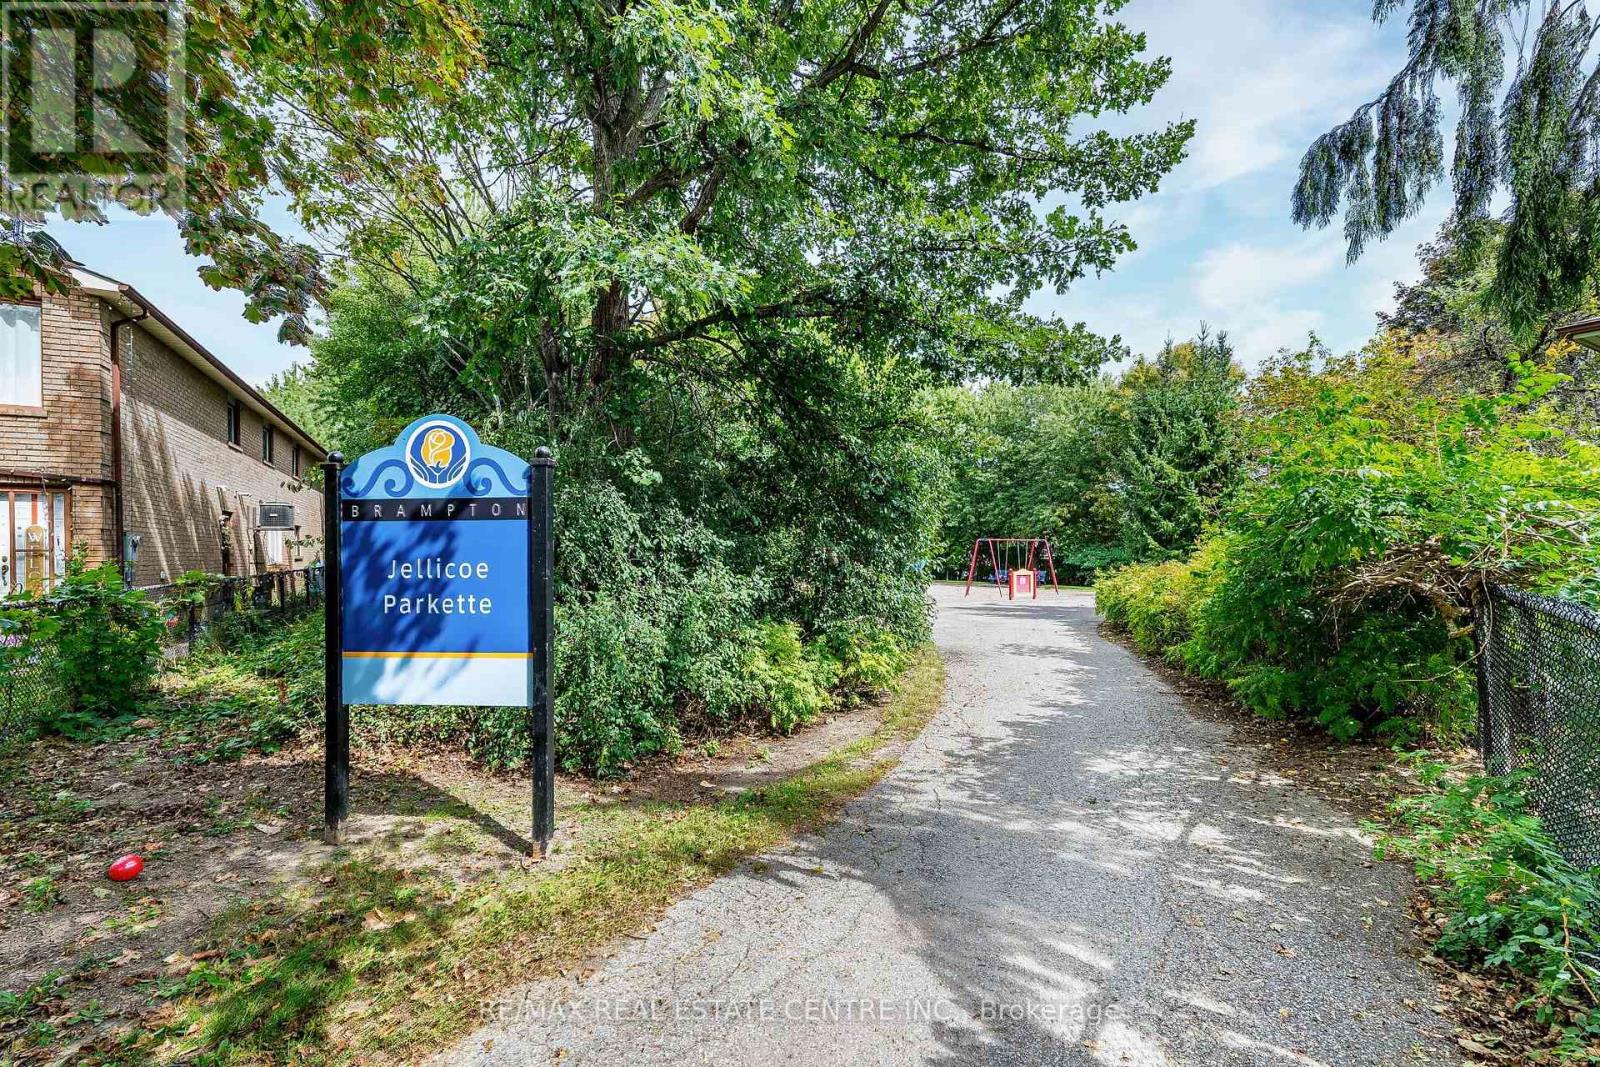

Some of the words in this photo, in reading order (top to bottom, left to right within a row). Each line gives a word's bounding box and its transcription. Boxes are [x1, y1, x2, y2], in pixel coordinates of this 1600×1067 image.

[351, 503, 526, 517] BRAMPTON
[387, 558, 489, 579] Jellicoe
[384, 594, 492, 614] Parkette
